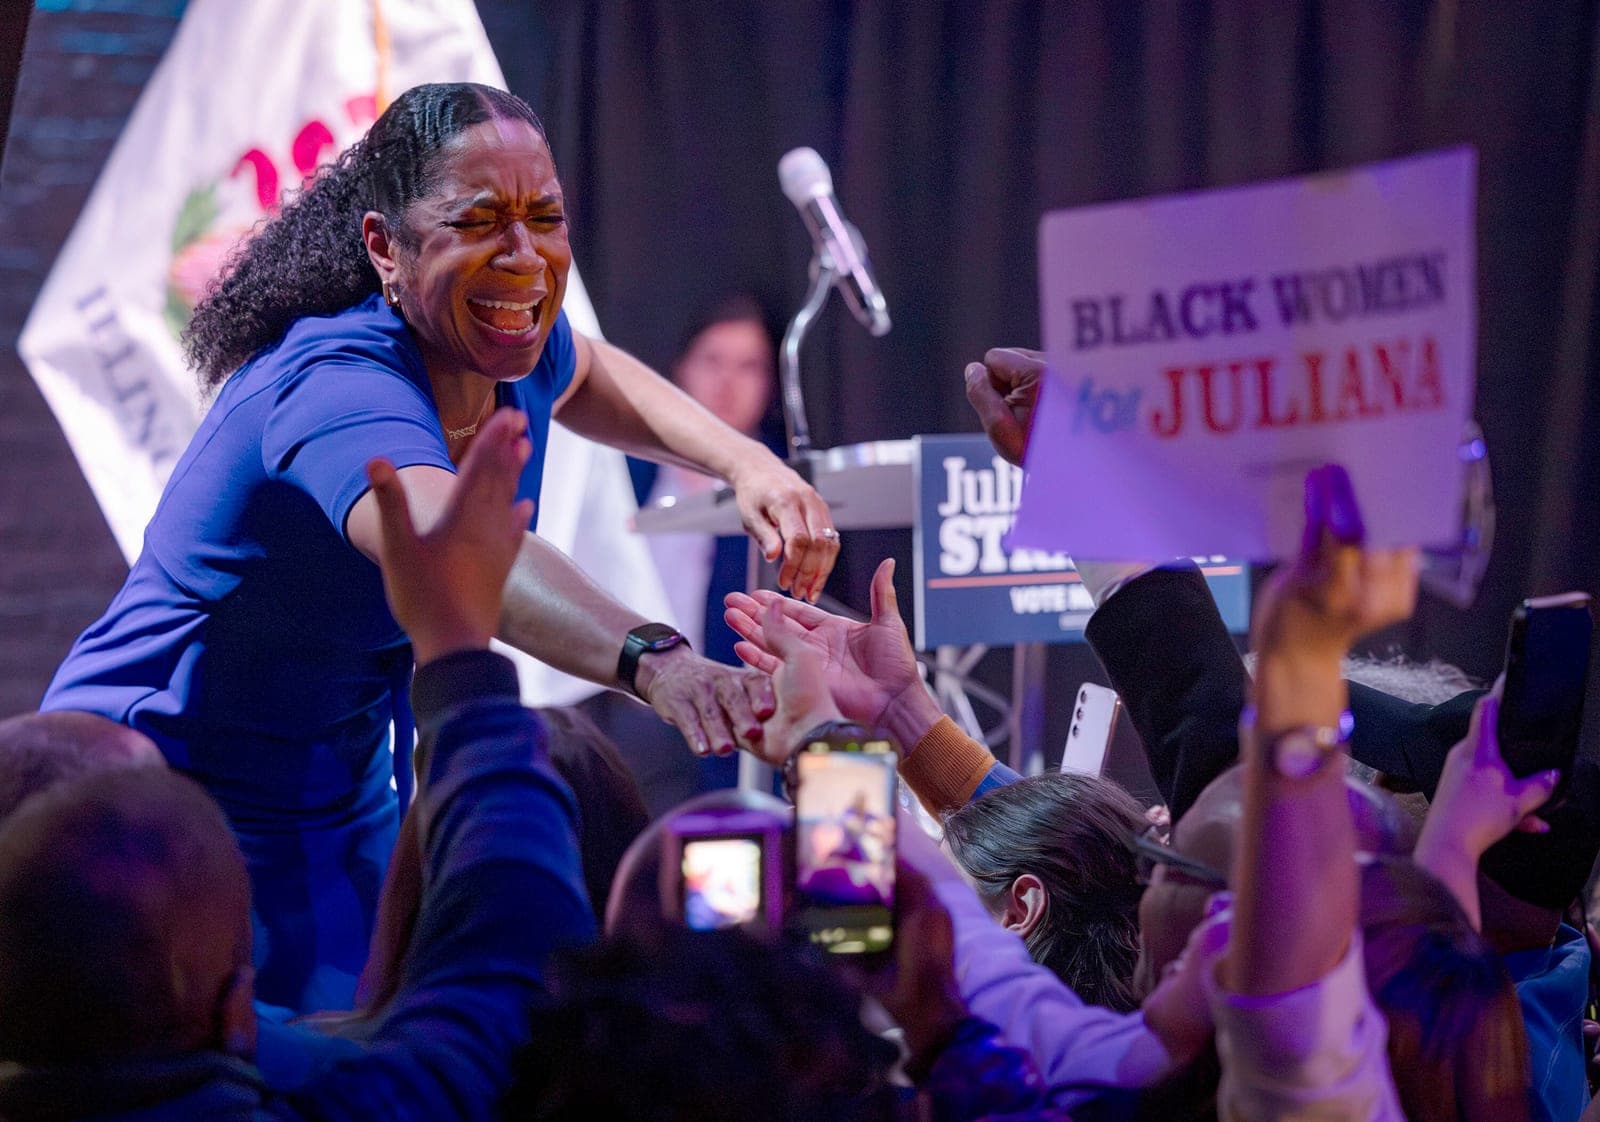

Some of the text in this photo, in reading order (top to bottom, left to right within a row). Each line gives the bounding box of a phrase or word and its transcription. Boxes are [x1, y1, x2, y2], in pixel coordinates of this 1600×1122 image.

[1070, 252, 1447, 351] BLACK WOMEN
[1072, 335, 1445, 438] for JULIANA
